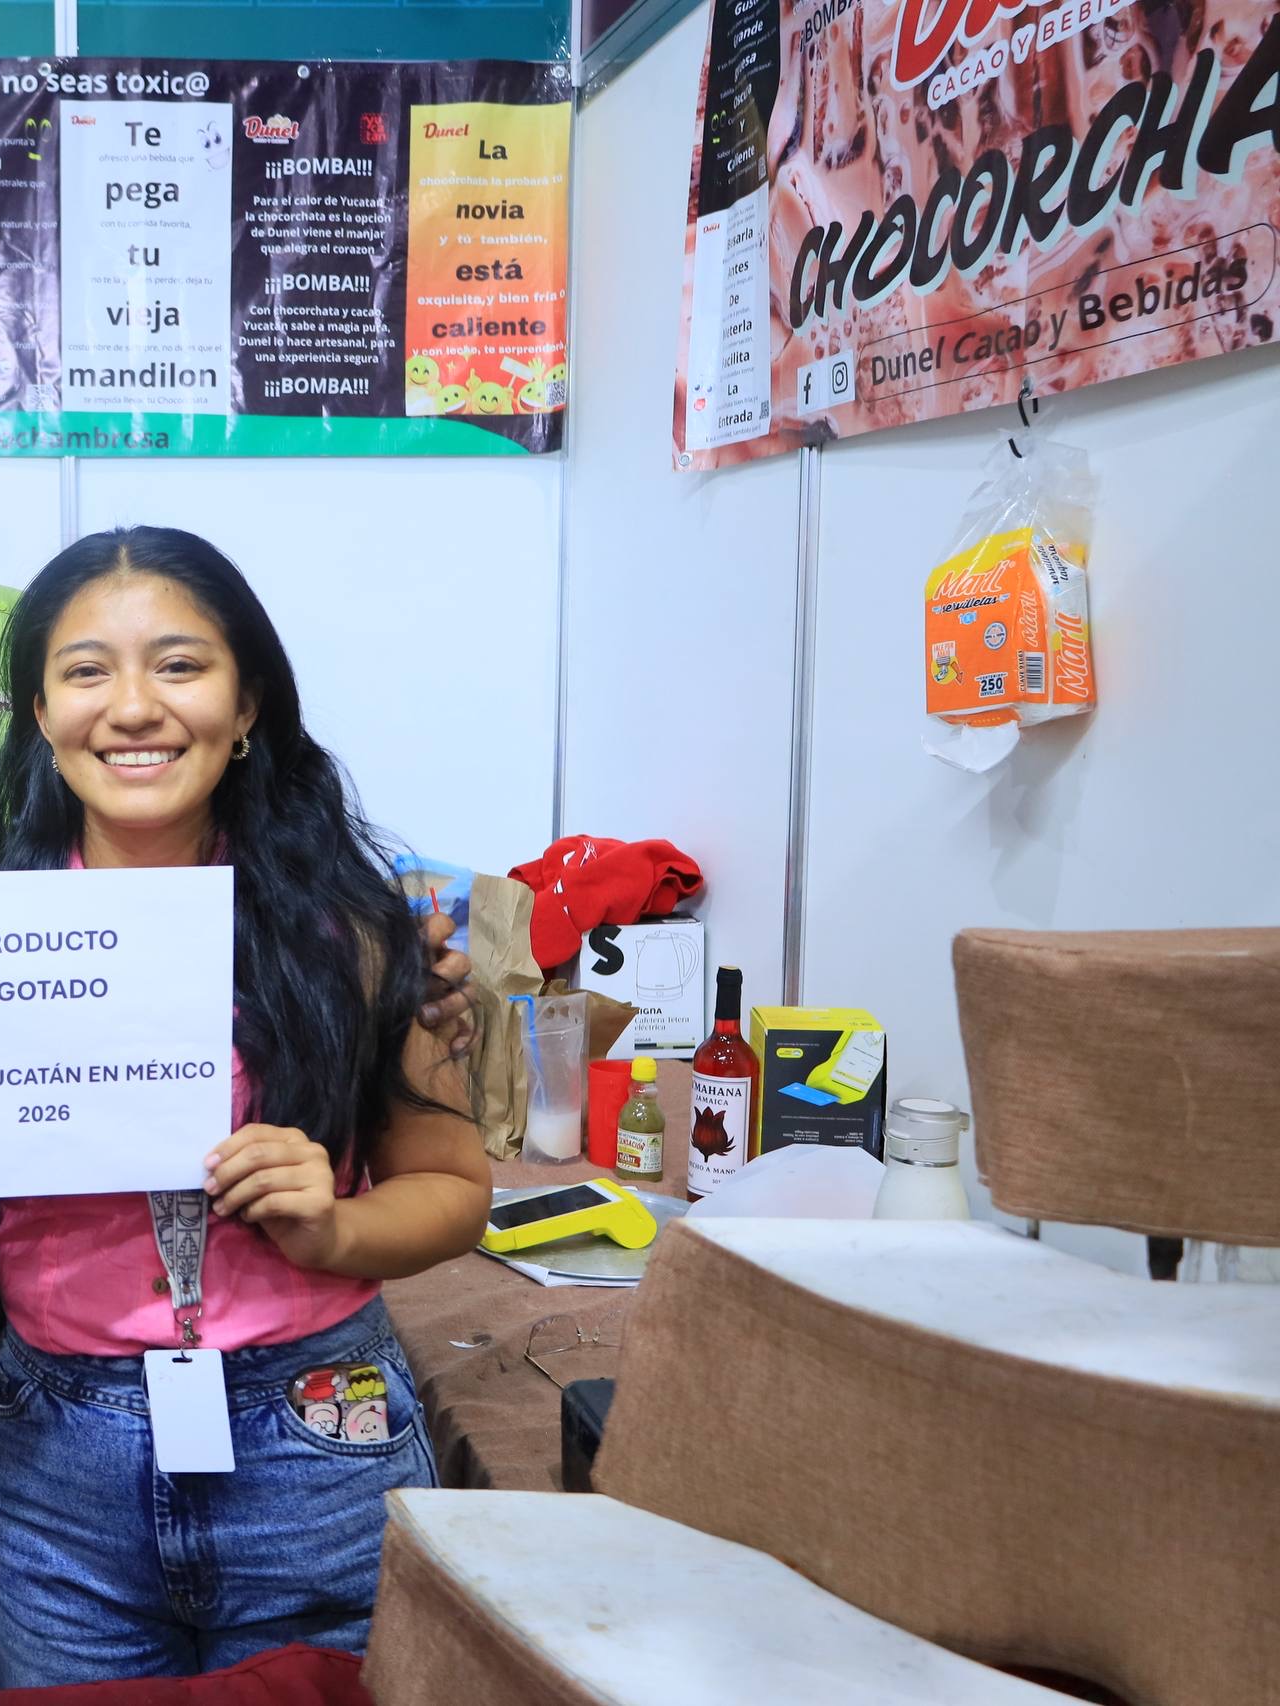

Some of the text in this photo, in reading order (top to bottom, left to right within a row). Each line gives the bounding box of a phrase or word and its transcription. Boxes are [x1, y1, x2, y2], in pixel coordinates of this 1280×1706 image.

[931, 50, 1004, 102] CACAO
[1017, 34, 1030, 54] Y
[3, 73, 38, 95] no
[46, 72, 108, 95] seas
[115, 70, 210, 98] toxic@
[124, 121, 161, 147] Te
[244, 116, 299, 139] Dunel
[422, 122, 470, 140] Dunel
[738, 119, 746, 134] Y
[479, 140, 508, 160] La
[265, 158, 373, 179] ¡¡¡BOMBA!!!
[106, 181, 180, 210] pega
[253, 195, 279, 207] Para
[281, 195, 292, 206] el
[293, 195, 322, 207] calor
[324, 195, 338, 207] de
[245, 211, 255, 222] la
[258, 212, 326, 222] chocorchata
[328, 214, 341, 222] es
[343, 212, 353, 222] la
[456, 200, 525, 220] novia
[250, 227, 386, 242] de Dunel viene el manjar
[439, 234, 449, 247] y
[128, 244, 160, 267] tu
[260, 245, 281, 256] que
[284, 243, 318, 256] alegra
[320, 243, 330, 254] el
[455, 258, 524, 282] está
[265, 274, 370, 295] ¡¡¡BOMBA!!!
[499, 292, 529, 304] bien
[249, 305, 271, 316] Con
[274, 305, 340, 317] chocorchata
[342, 308, 350, 319] y
[871, 253, 1248, 386] Dunel Cacao y Bebidas
[291, 320, 317, 332] sabe
[319, 323, 325, 332] a
[327, 321, 360, 335] magia
[432, 317, 547, 338] caliente
[239, 335, 396, 352] Dunel lo hace artesanal, para
[255, 352, 380, 367] una experiencia segura
[69, 362, 217, 389] mandilon
[264, 377, 370, 398] ¡¡¡BOMBA!!!
[727, 383, 739, 397] La
[942, 596, 998, 613] servilletas
[980, 677, 1003, 692] 250
[89, 1065, 119, 1083] EN
[125, 1059, 216, 1081] MÉXICO
[696, 1094, 729, 1106] JAMAICA
[18, 1104, 71, 1123] 2026
